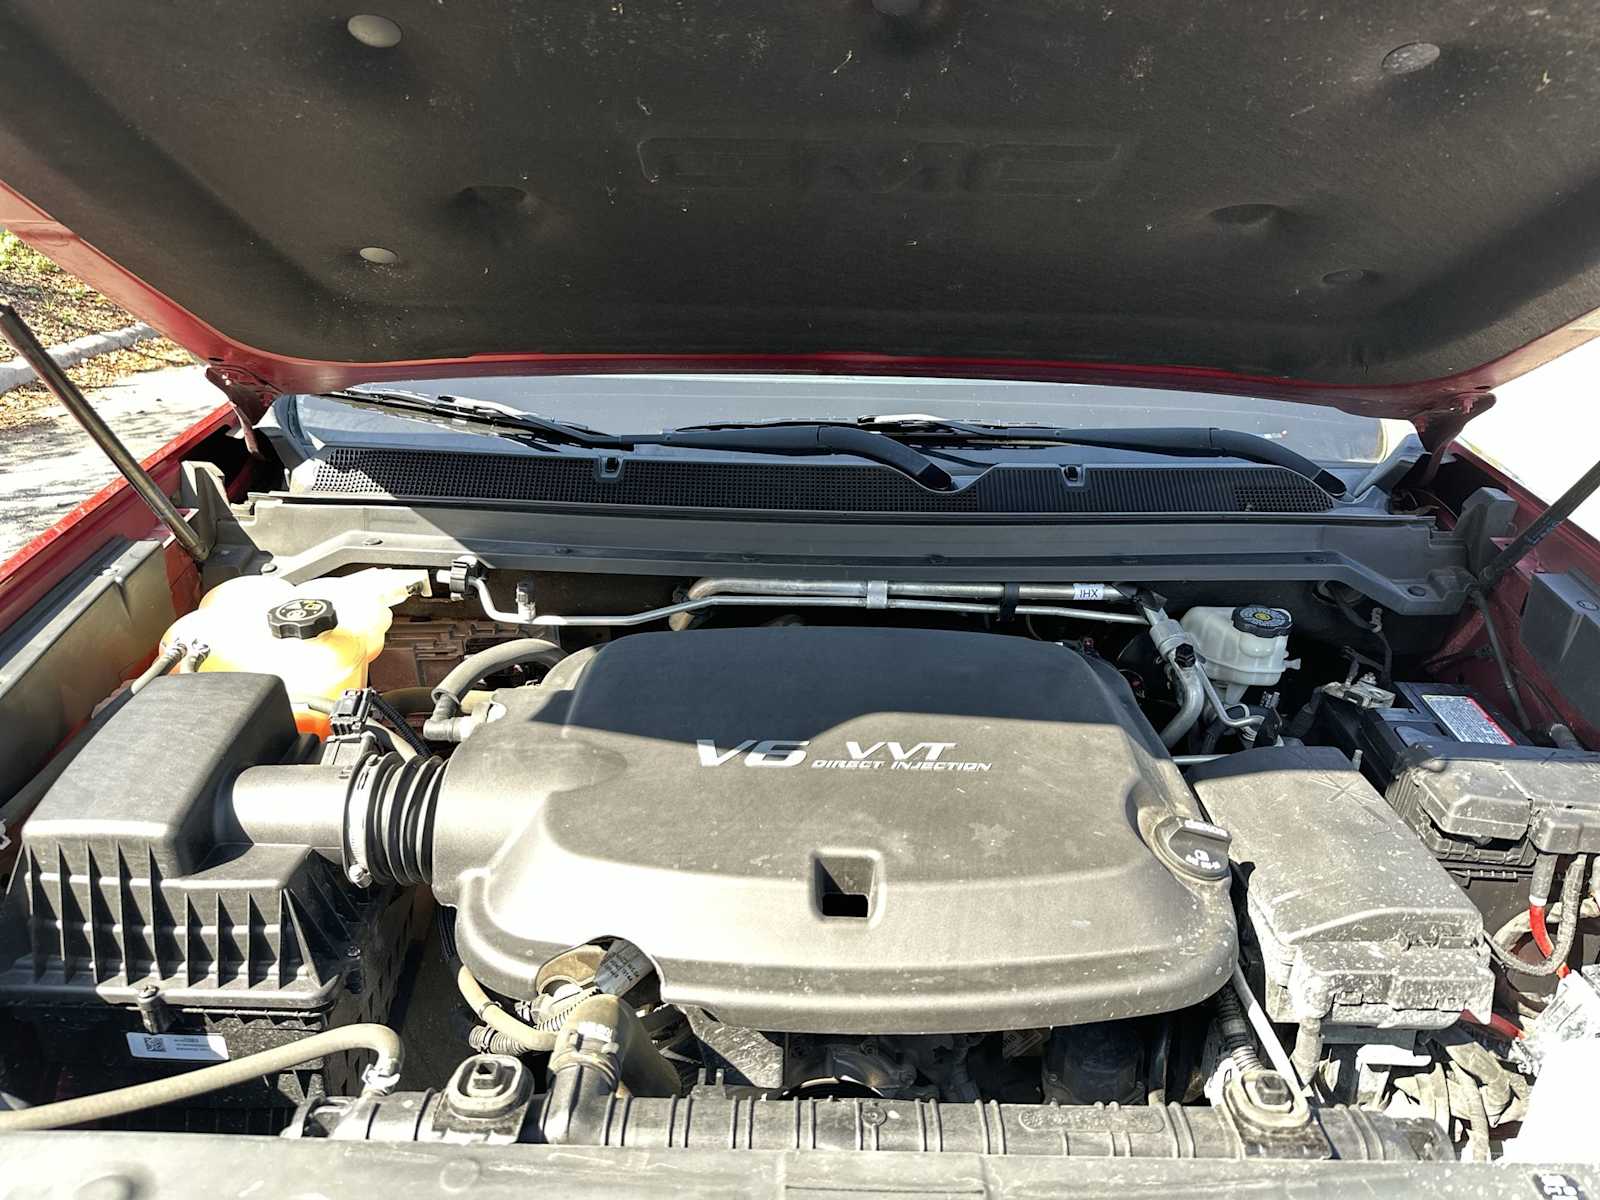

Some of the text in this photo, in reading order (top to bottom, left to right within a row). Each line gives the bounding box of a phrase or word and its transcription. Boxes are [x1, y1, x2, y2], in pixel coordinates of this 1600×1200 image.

[696, 739, 958, 767] V6 VVT
[811, 759, 993, 772] DIRECT INJECTION
